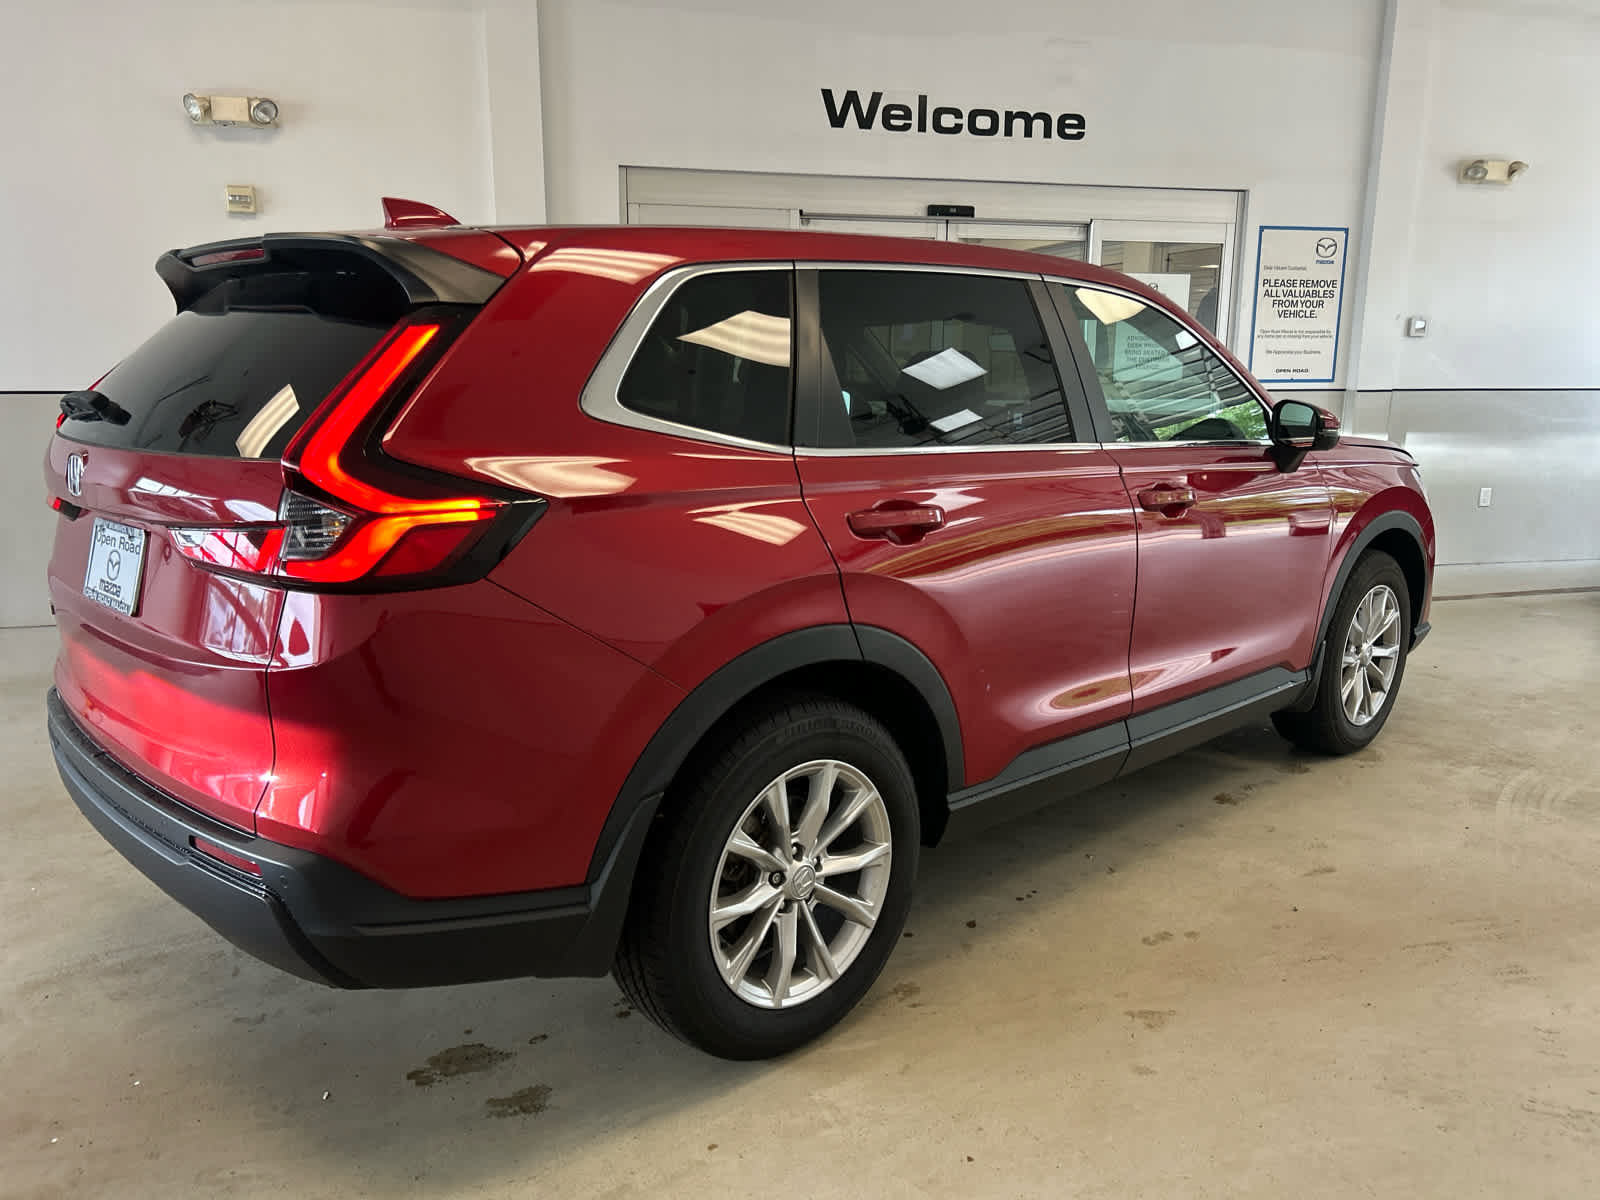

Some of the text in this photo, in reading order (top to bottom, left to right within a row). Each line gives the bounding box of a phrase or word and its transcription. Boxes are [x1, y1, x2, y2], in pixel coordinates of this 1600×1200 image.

[820, 88, 1086, 141] Welcome
[1262, 279, 1338, 289] PLEASE REMOVE
[1263, 289, 1335, 299] ALL VALUABLES
[1272, 299, 1325, 309] FROM YOUR
[1277, 309, 1318, 319] VEHICLE.
[96, 529, 141, 555] Open Road
[99, 579, 121, 597] mazda
